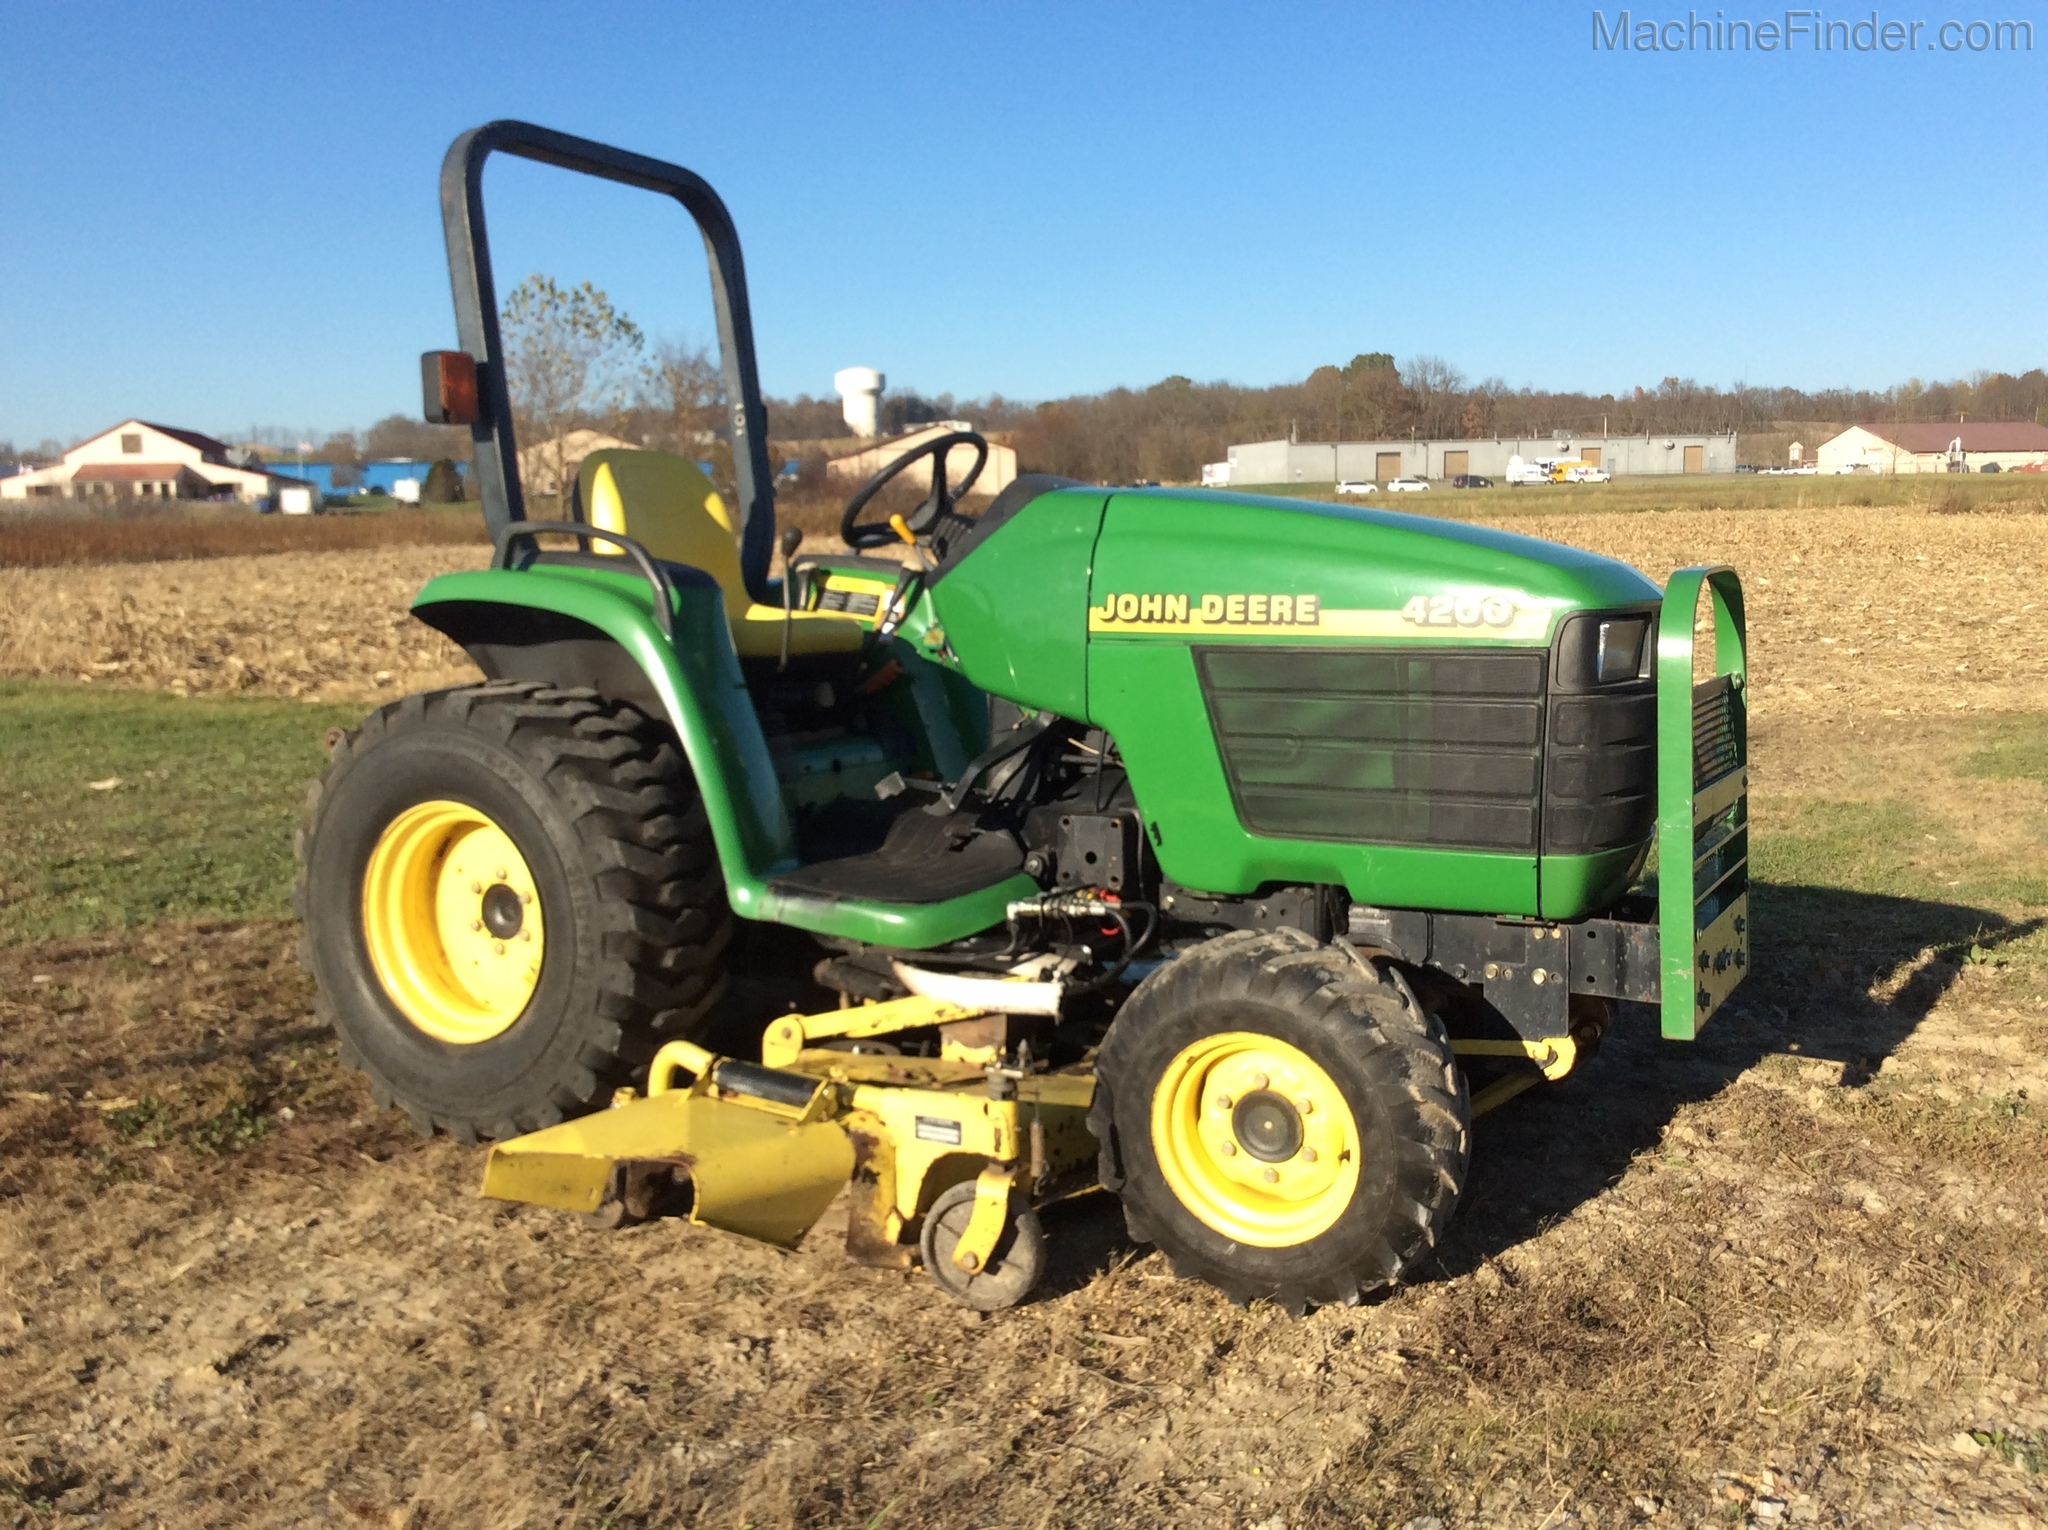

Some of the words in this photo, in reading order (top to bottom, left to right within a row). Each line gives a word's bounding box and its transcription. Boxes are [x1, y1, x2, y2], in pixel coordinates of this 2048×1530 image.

[1097, 593, 1190, 623] JOHN
[1201, 594, 1319, 626] DEERE
[1402, 595, 1516, 629] 4200
